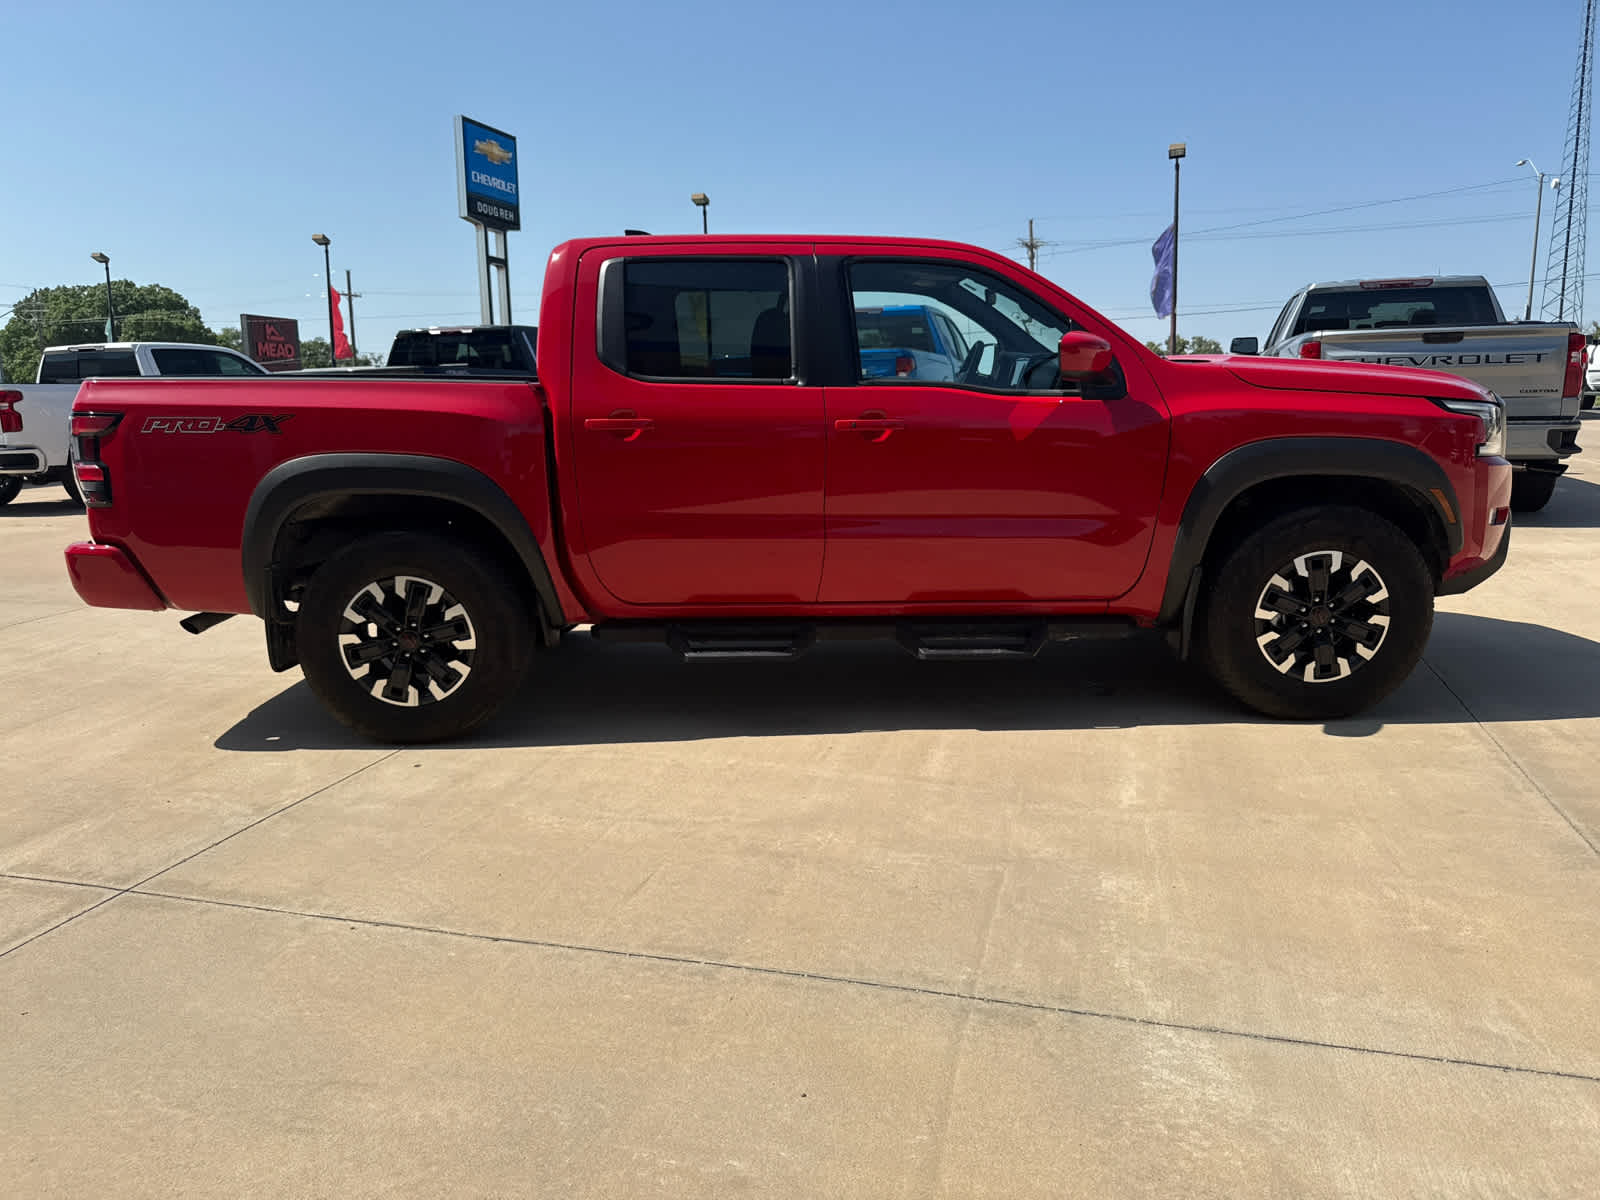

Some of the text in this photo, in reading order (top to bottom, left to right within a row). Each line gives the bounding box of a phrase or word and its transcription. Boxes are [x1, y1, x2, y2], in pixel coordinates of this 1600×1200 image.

[471, 171, 517, 194] CHEVROLET
[257, 341, 296, 358] MEAD
[1337, 352, 1549, 367] HEVROLET
